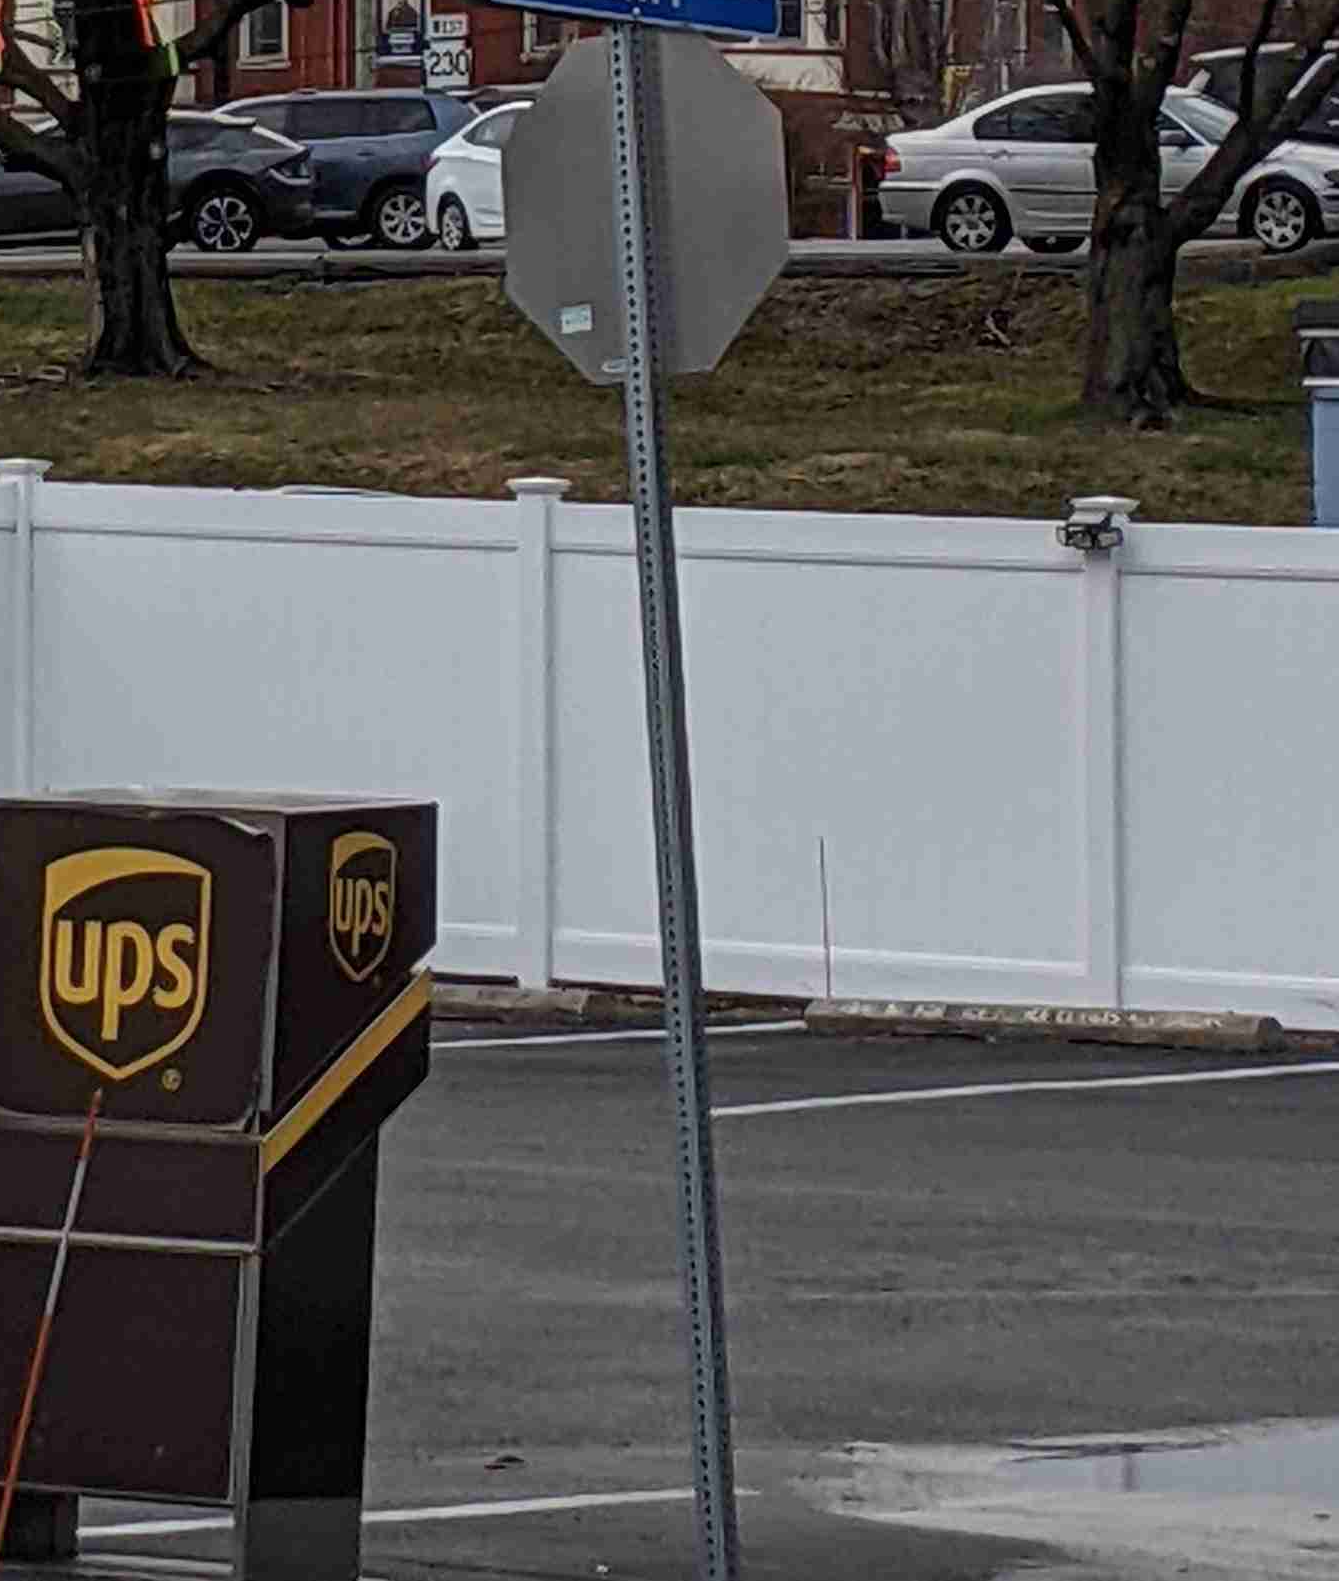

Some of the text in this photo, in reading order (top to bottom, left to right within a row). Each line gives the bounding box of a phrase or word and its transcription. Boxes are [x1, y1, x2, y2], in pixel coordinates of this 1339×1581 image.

[429, 50, 469, 76] 230
[334, 877, 389, 958] ups
[54, 919, 196, 1042] ups
